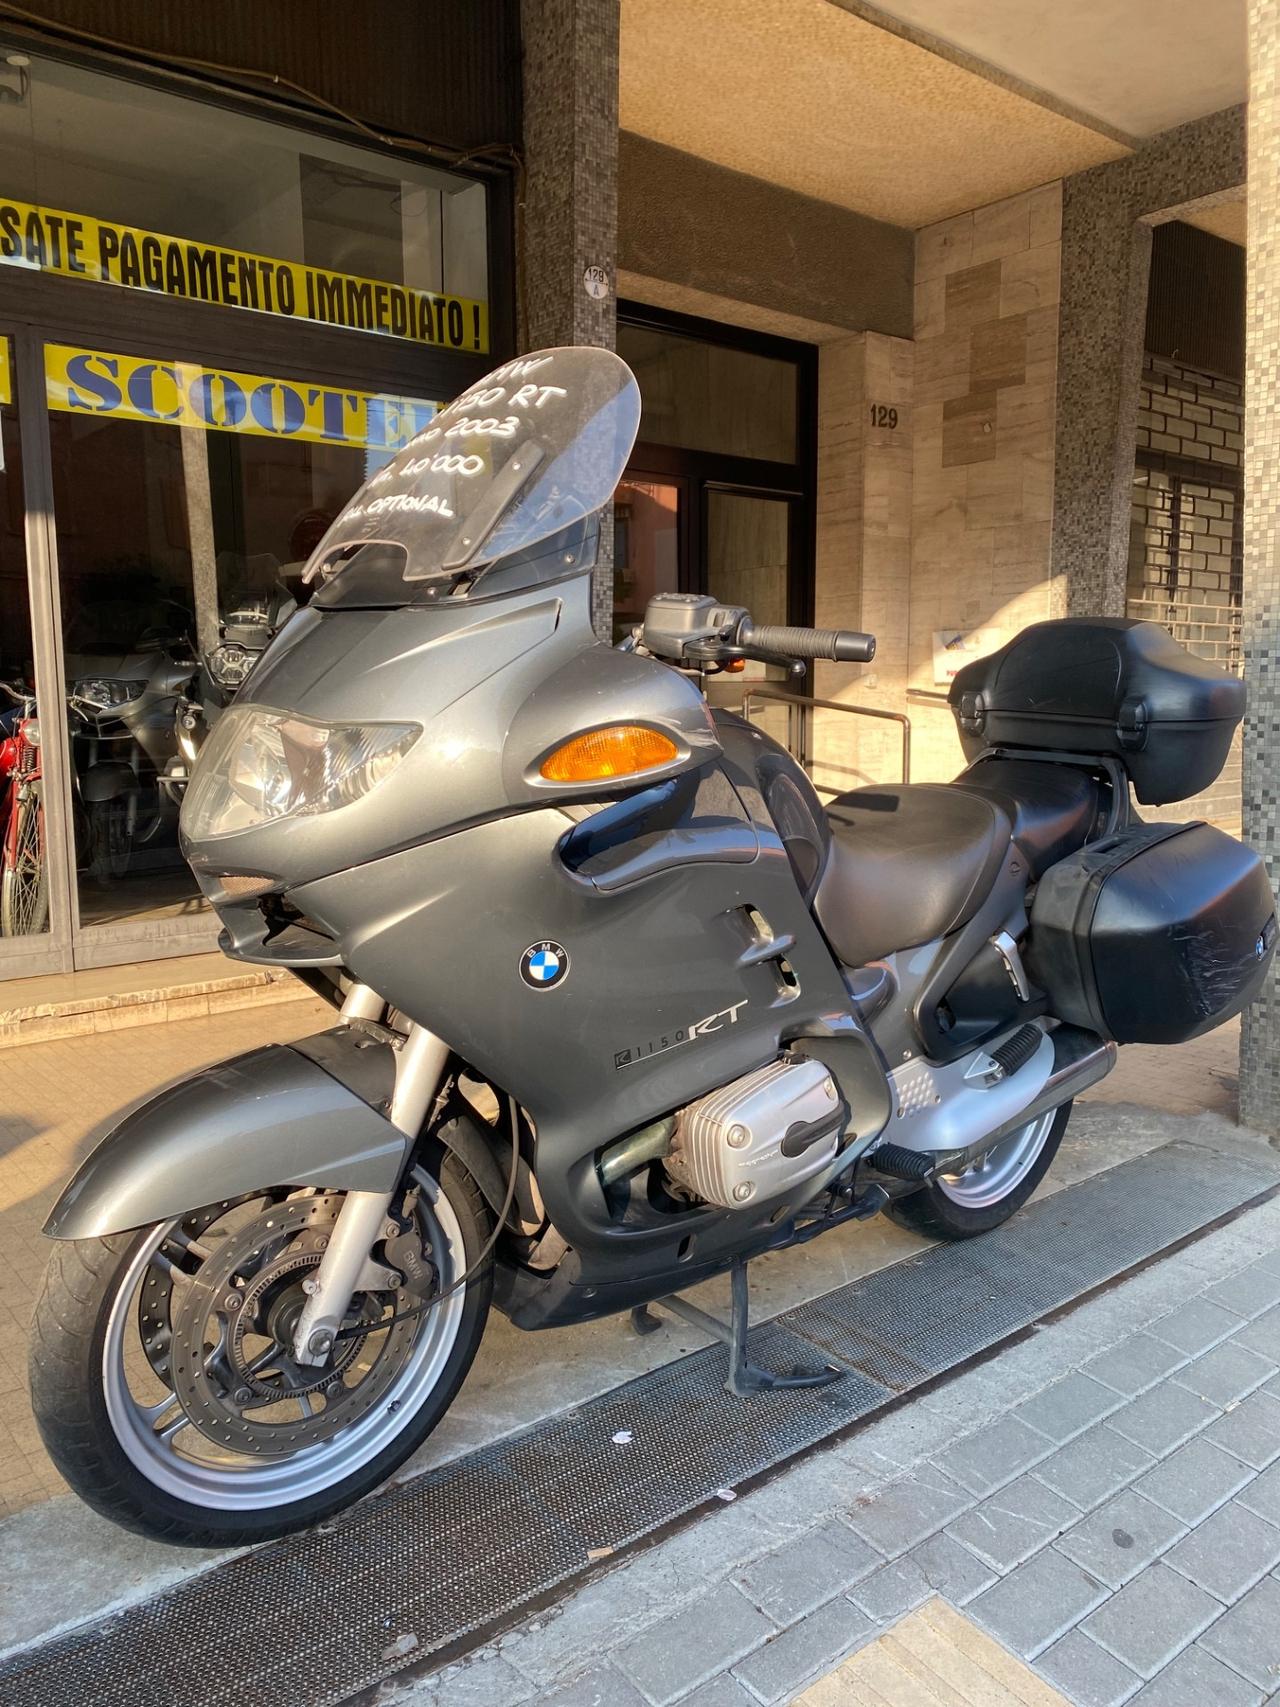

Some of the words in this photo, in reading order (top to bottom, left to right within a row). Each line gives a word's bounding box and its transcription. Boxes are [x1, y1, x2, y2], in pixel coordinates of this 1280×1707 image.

[0, 204, 86, 273] SATE
[98, 226, 296, 316] PAGAMENTO
[305, 271, 465, 347] IMMEDIATO
[588, 268, 604, 283] 129
[508, 384, 568, 409] RT
[445, 415, 521, 439] 2003
[870, 403, 898, 430] 129
[367, 494, 455, 519] OPTIONAL
[404, 1250, 424, 1280] BMW
